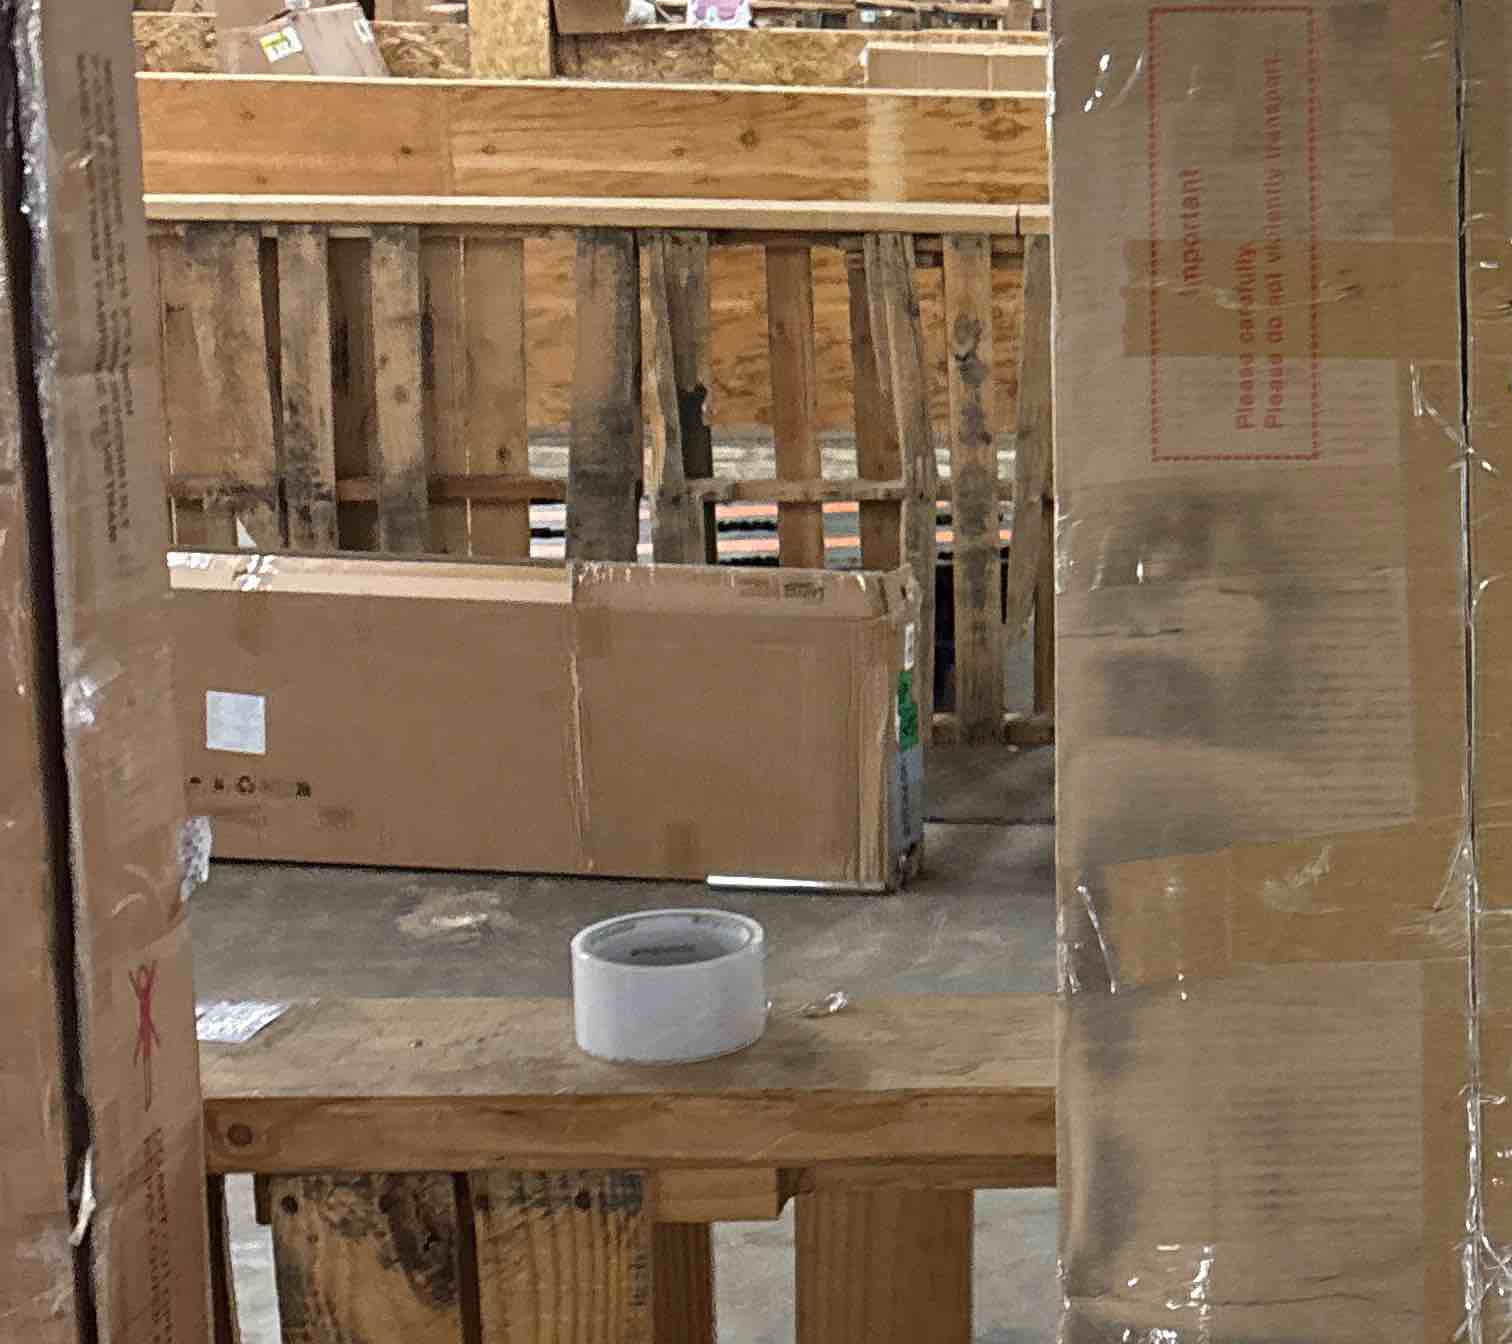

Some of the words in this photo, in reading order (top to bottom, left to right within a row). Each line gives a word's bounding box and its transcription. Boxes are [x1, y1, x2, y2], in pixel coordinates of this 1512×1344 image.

[1264, 167, 1286, 264] violently
[1264, 272, 1284, 306] not
[1264, 316, 1284, 345] do
[1236, 355, 1256, 431] Please
[1264, 353, 1284, 431] Please
